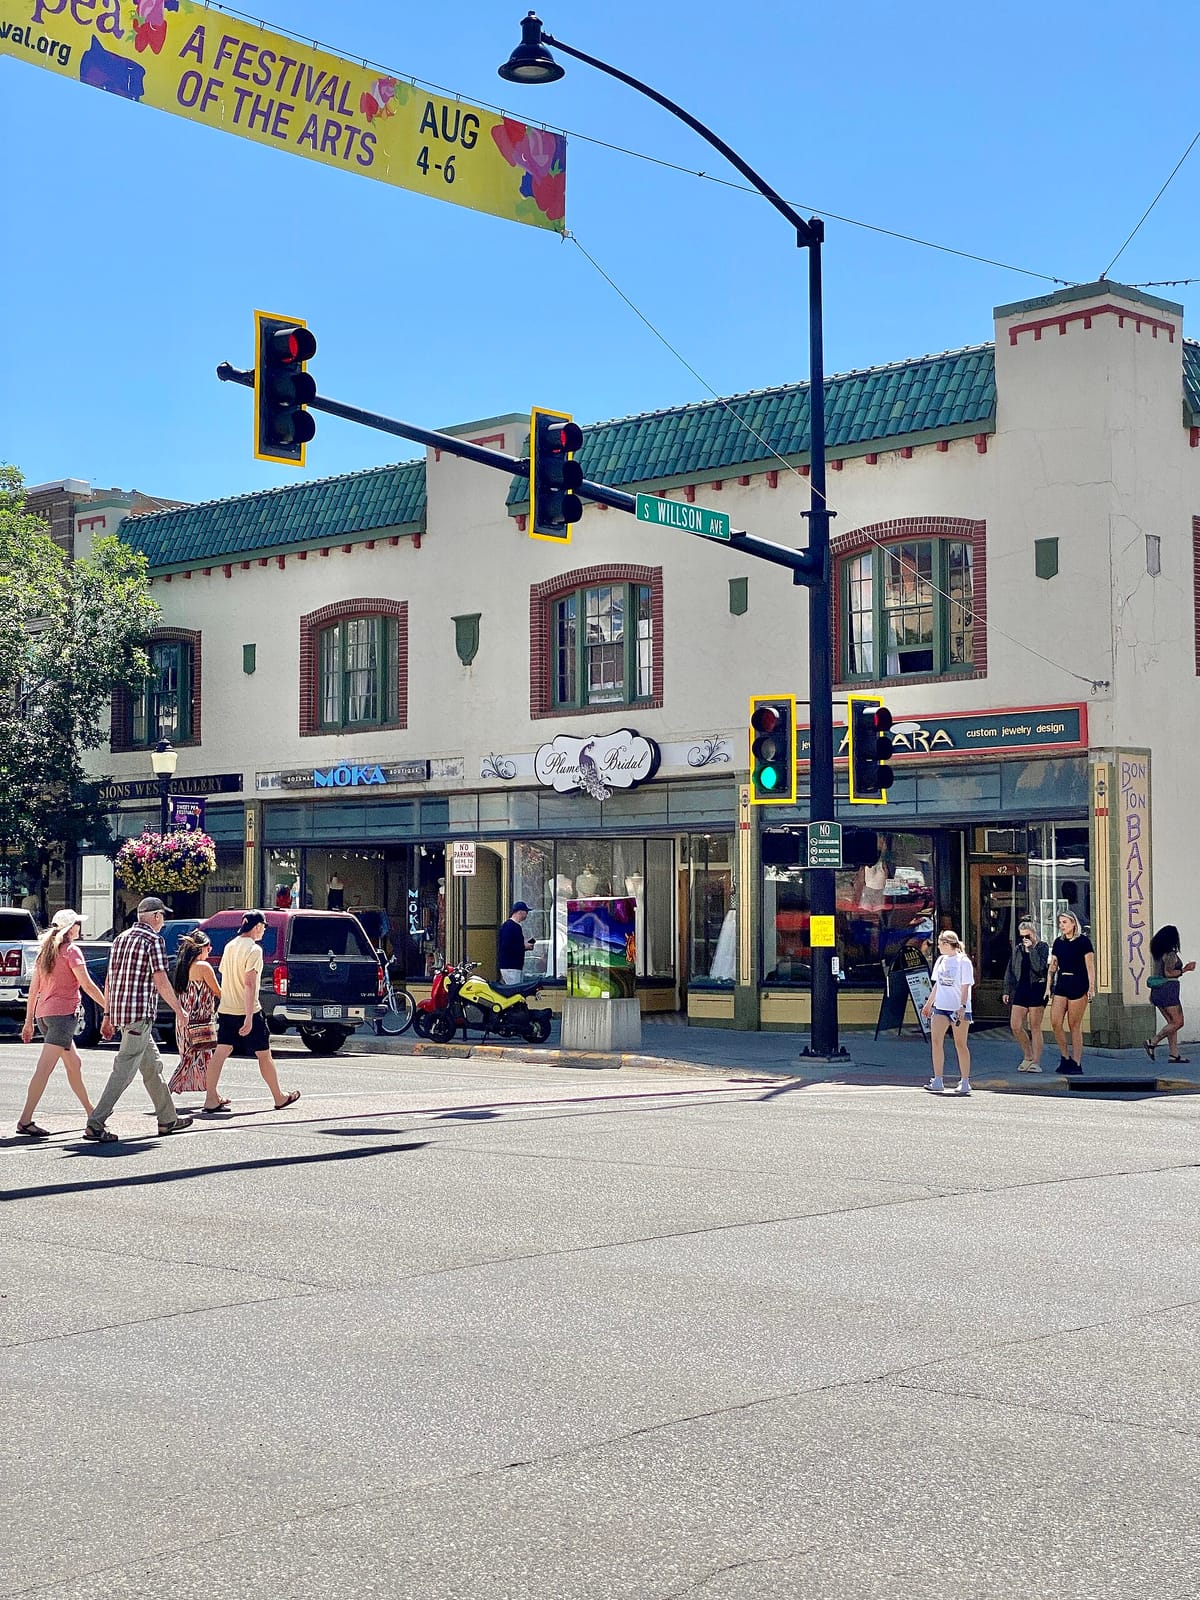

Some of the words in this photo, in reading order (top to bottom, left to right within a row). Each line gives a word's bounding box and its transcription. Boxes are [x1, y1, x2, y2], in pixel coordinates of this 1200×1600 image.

[179, 25, 206, 64] A
[213, 34, 354, 117] FESTIVAL
[177, 70, 224, 112] OF
[232, 86, 295, 140] THE
[296, 113, 378, 167] ARTS
[419, 101, 481, 150] AUG
[416, 145, 456, 184] 4-6
[644, 503, 649, 519] S
[657, 501, 702, 531] WILLSON
[709, 518, 724, 536] AVE
[966, 728, 997, 738] custom
[1001, 725, 1031, 737] jewelry
[1036, 722, 1065, 736] design
[542, 751, 580, 775] Plume
[600, 744, 648, 771] Bridal
[1122, 761, 1147, 787] BON
[136, 782, 160, 796] WES
[169, 777, 223, 794] GALLERY
[1122, 786, 1147, 810] TON
[820, 824, 830, 835] NO
[1126, 813, 1146, 996] BAKERY
